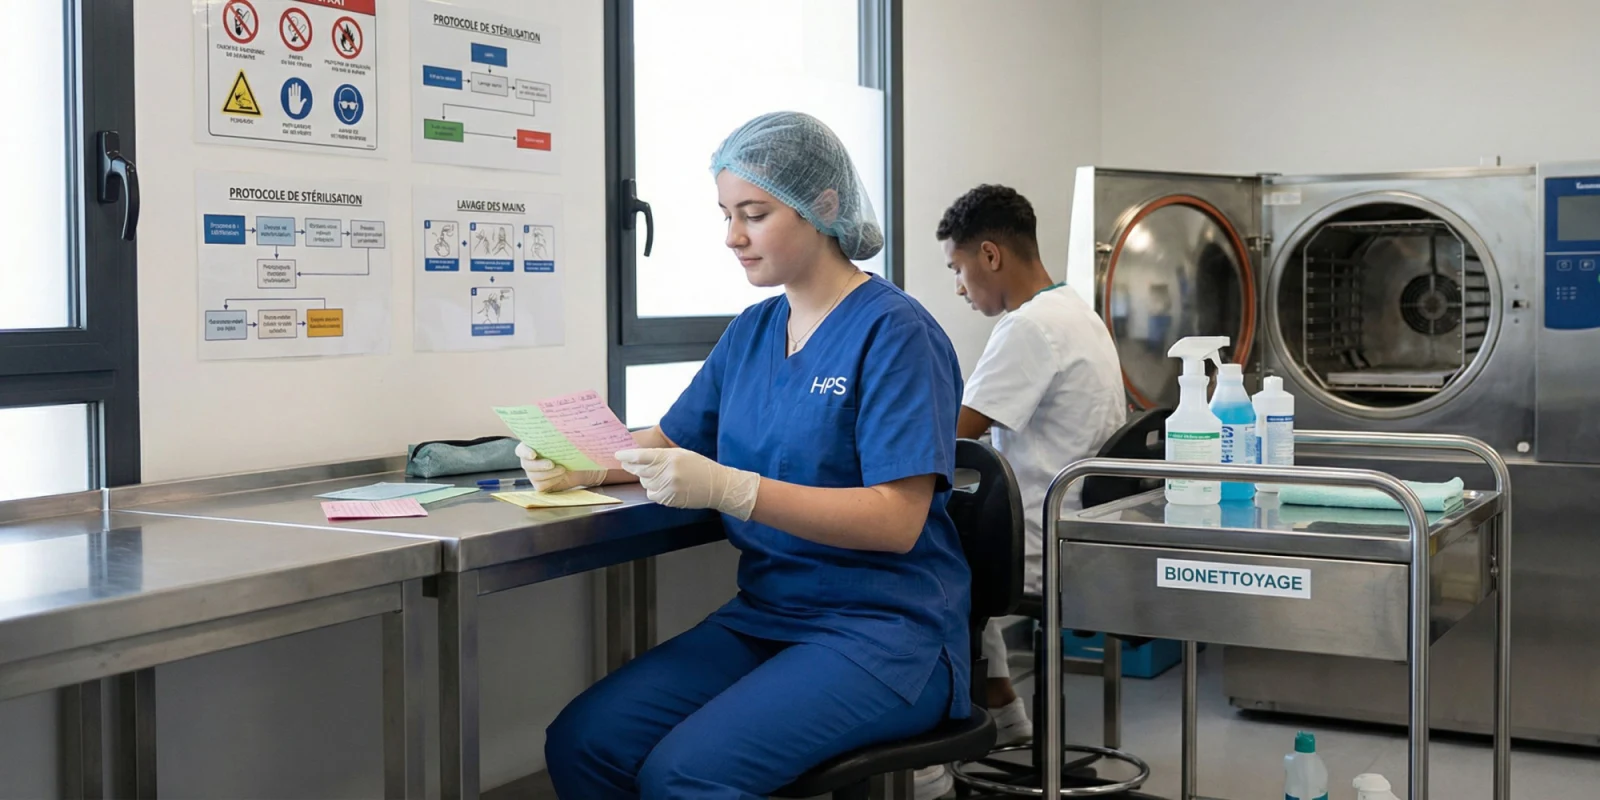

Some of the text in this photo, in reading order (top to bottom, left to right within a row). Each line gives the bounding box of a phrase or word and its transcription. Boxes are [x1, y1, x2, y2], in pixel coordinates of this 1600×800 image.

[433, 13, 541, 42] PROTOCOLE DE STÉRILISATION
[229, 187, 363, 206] PROTOCOLE DE STÉRILISATION
[457, 199, 526, 212] LAVAGE DES MAINS
[810, 376, 847, 396] HPS
[1165, 566, 1303, 590] BIONETTOYAGE
